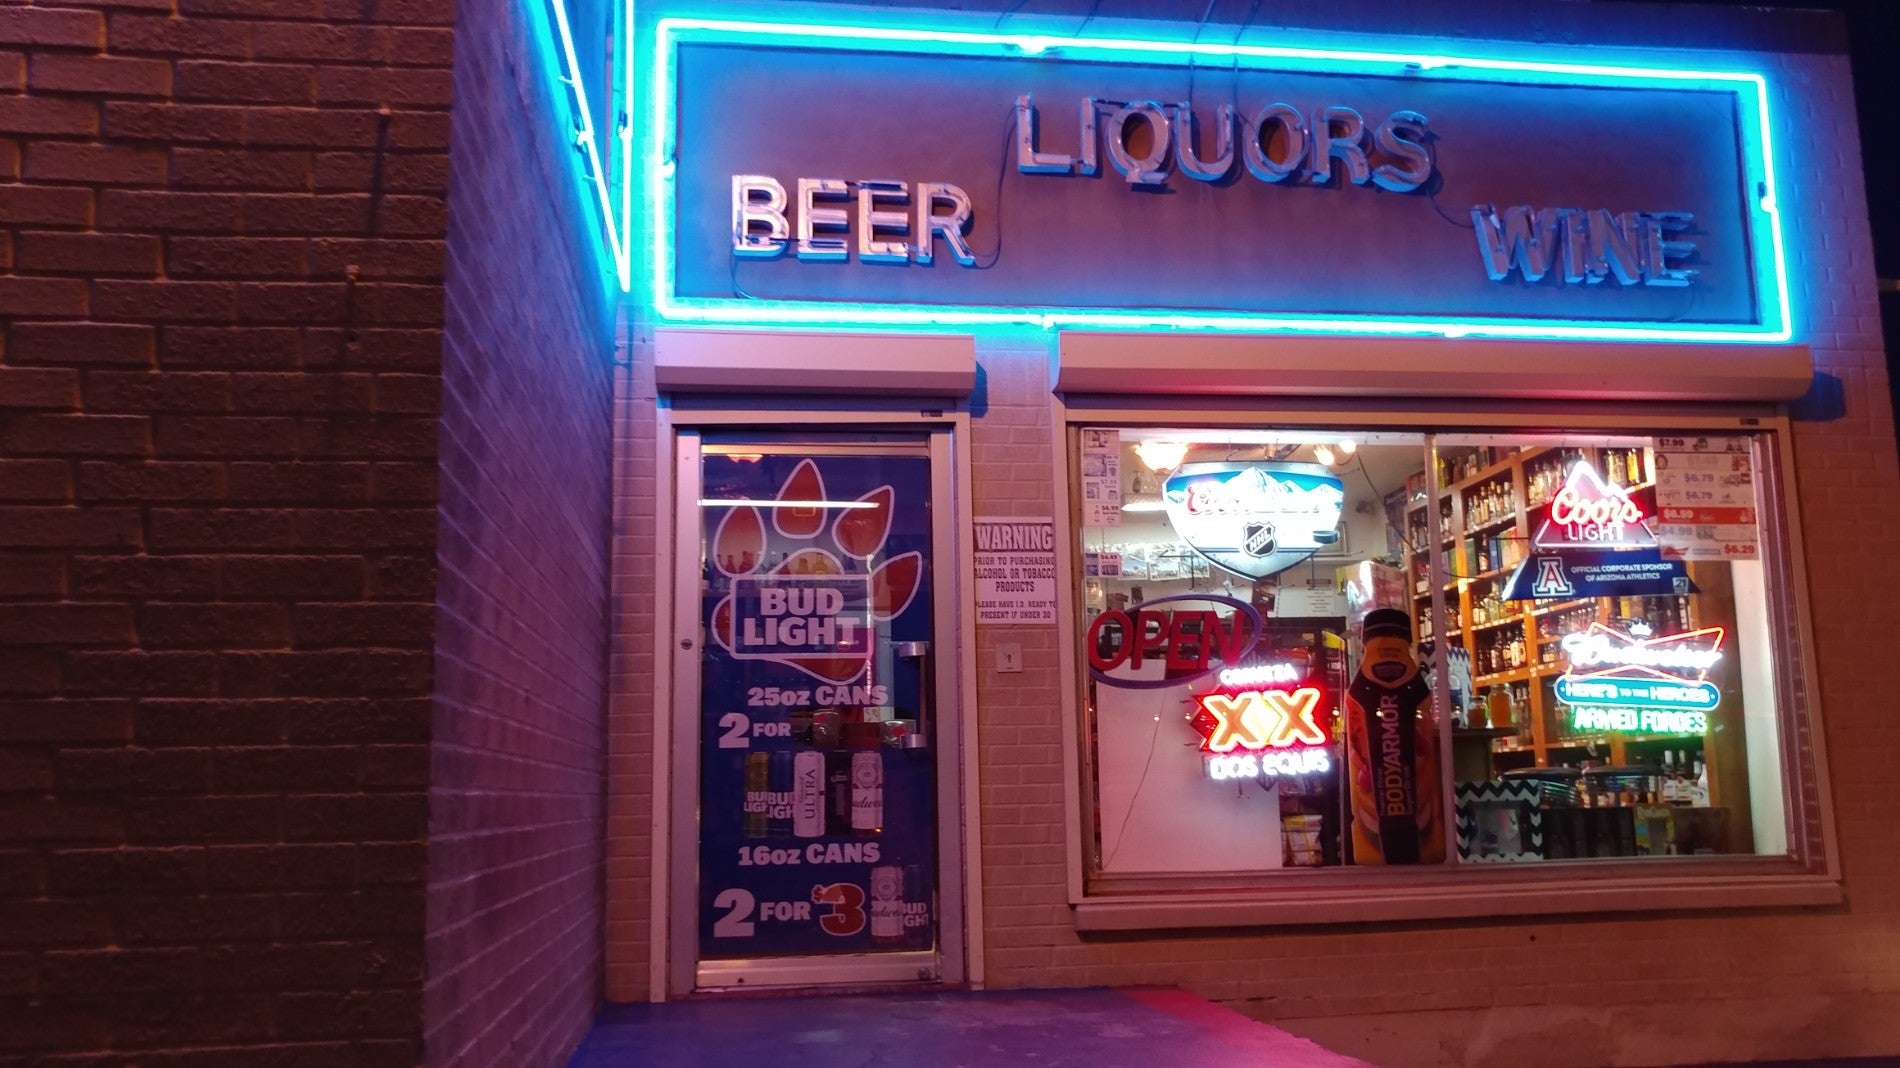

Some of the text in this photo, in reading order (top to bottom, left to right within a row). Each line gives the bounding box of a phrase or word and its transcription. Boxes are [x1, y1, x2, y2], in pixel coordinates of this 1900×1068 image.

[1015, 93, 1438, 193] LIQUORS
[730, 173, 976, 266] BEER
[1469, 203, 1700, 288] WINE
[1552, 486, 1643, 526] Coors
[975, 525, 1053, 550] WARNING
[1248, 526, 1273, 550] NHL
[1567, 522, 1625, 541] LIGHT
[974, 556, 1055, 566] PRIOR TO PURCHASING
[974, 568, 1055, 579] ALCOHOL OR TOBACCO
[1570, 562, 1673, 574] OFFICIAL CORPORATE SPONSOR
[995, 581, 1035, 592] PRODUCTS
[1596, 573, 1626, 582] ARIZONA
[1627, 572, 1660, 580] ATHLETICS
[760, 586, 845, 617] BUD
[980, 611, 1009, 619] PRESENT
[1011, 611, 1018, 619] IF
[1020, 611, 1041, 619] UNDER
[743, 616, 861, 648] LIGHT
[1087, 609, 1246, 672] OPEN
[747, 685, 889, 706] 25oz CANS
[718, 712, 792, 749] 2 FOR
[1203, 688, 1326, 752] XX
[1574, 706, 1708, 733] ARMED FORCES
[1210, 755, 1258, 780] DOS
[1380, 694, 1406, 817] BODYARMOR
[805, 769, 816, 819] ULTRA
[738, 842, 881, 866] 16oz CANS
[713, 883, 866, 938] 2 FOR $3
